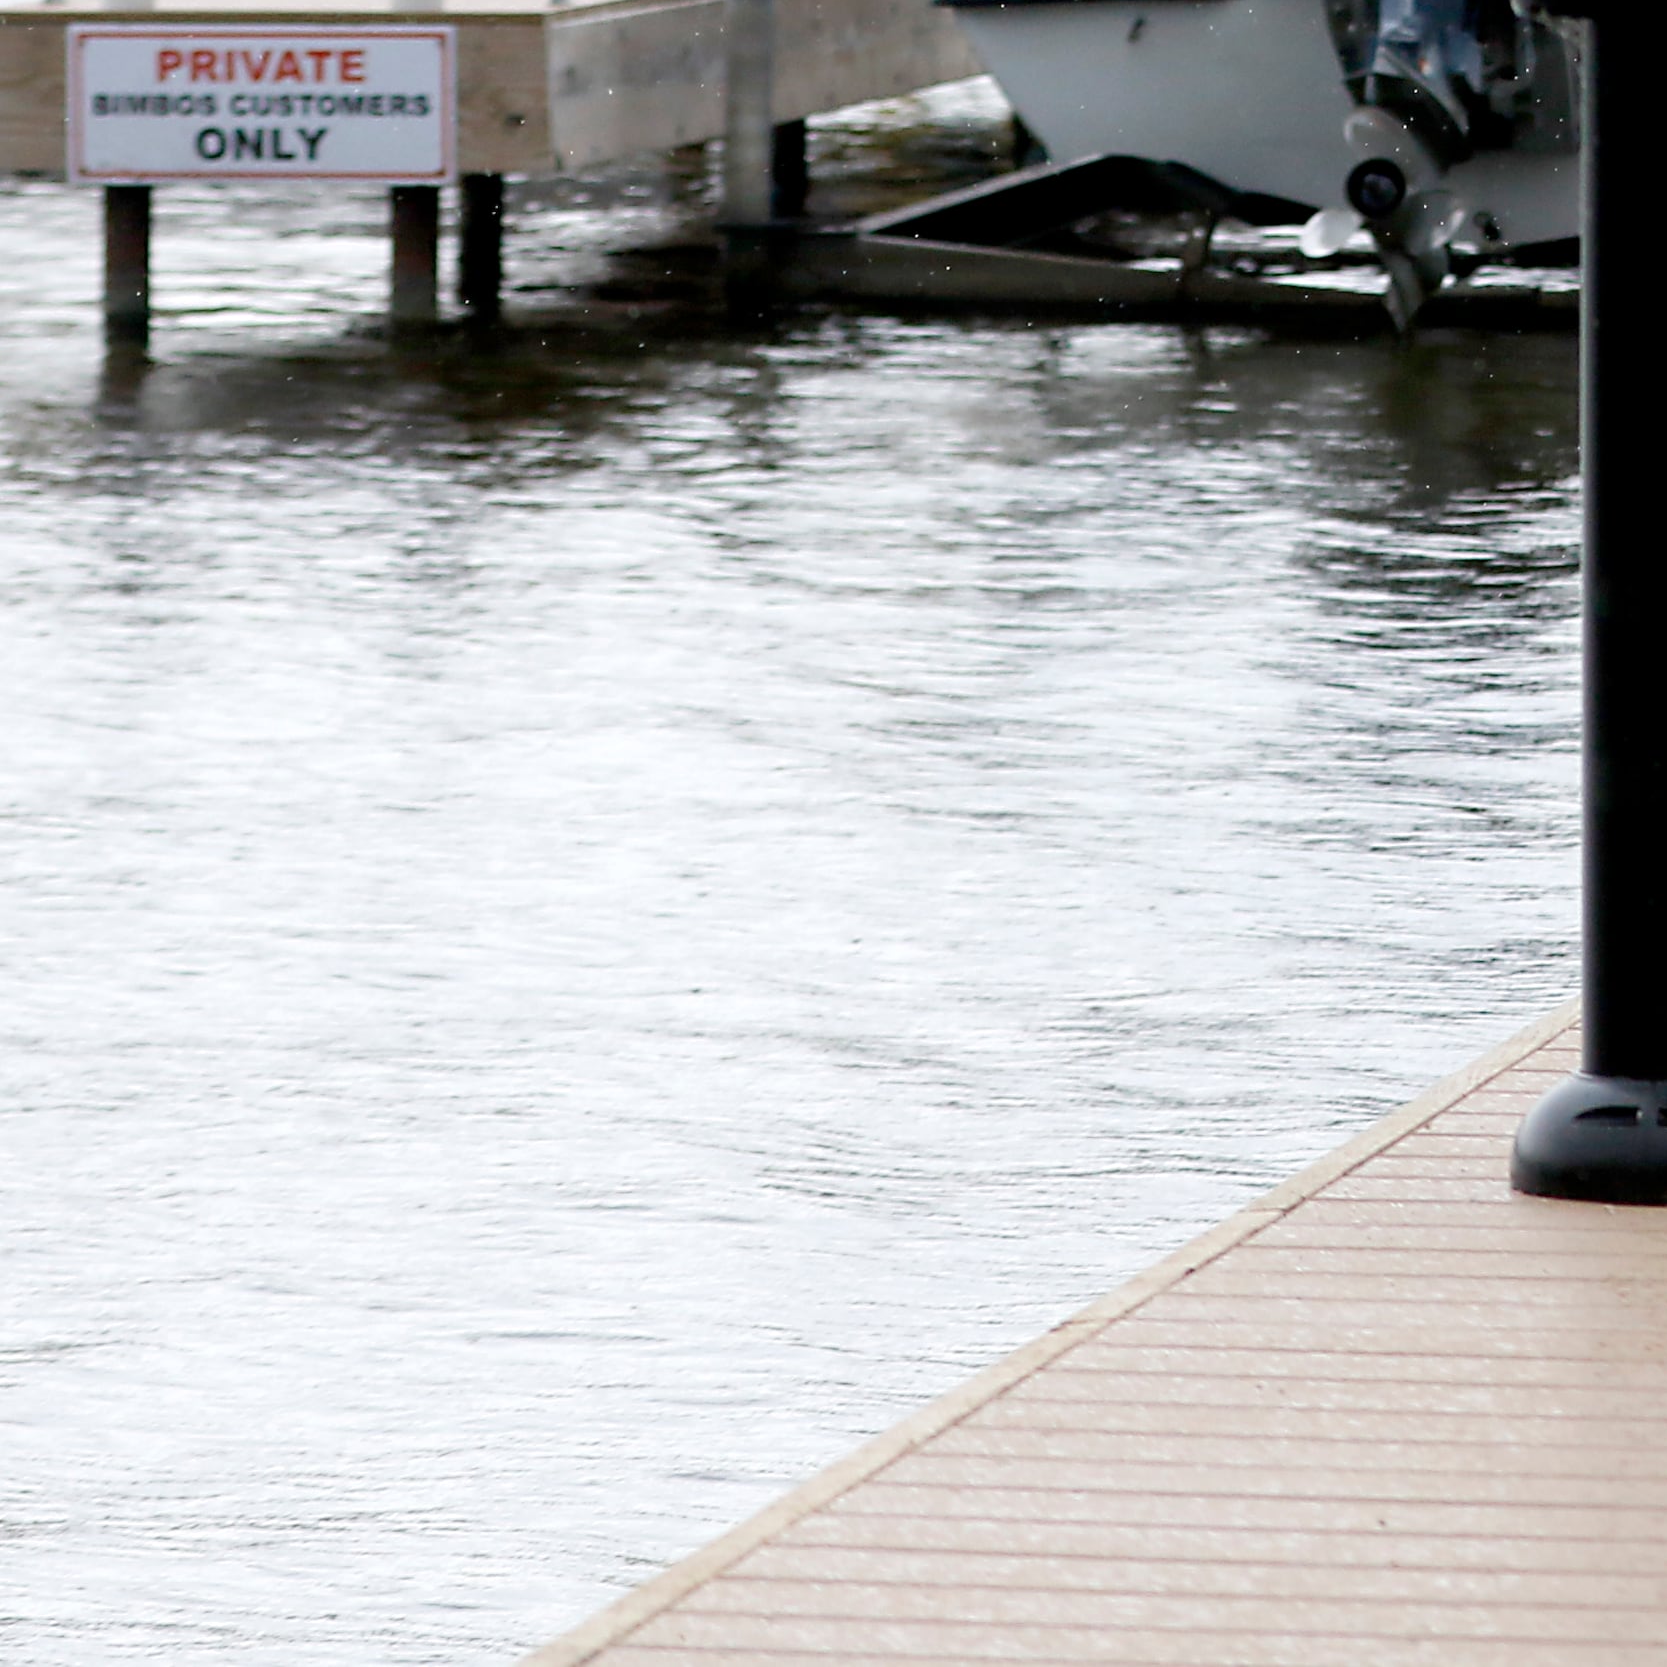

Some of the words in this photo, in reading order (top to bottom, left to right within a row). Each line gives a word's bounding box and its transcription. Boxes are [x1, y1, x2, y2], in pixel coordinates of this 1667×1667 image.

[155, 48, 367, 83] PRIVATE
[92, 93, 216, 117] BIMBOS
[229, 93, 431, 117] CUSTOMERS
[194, 126, 329, 162] ONLY
